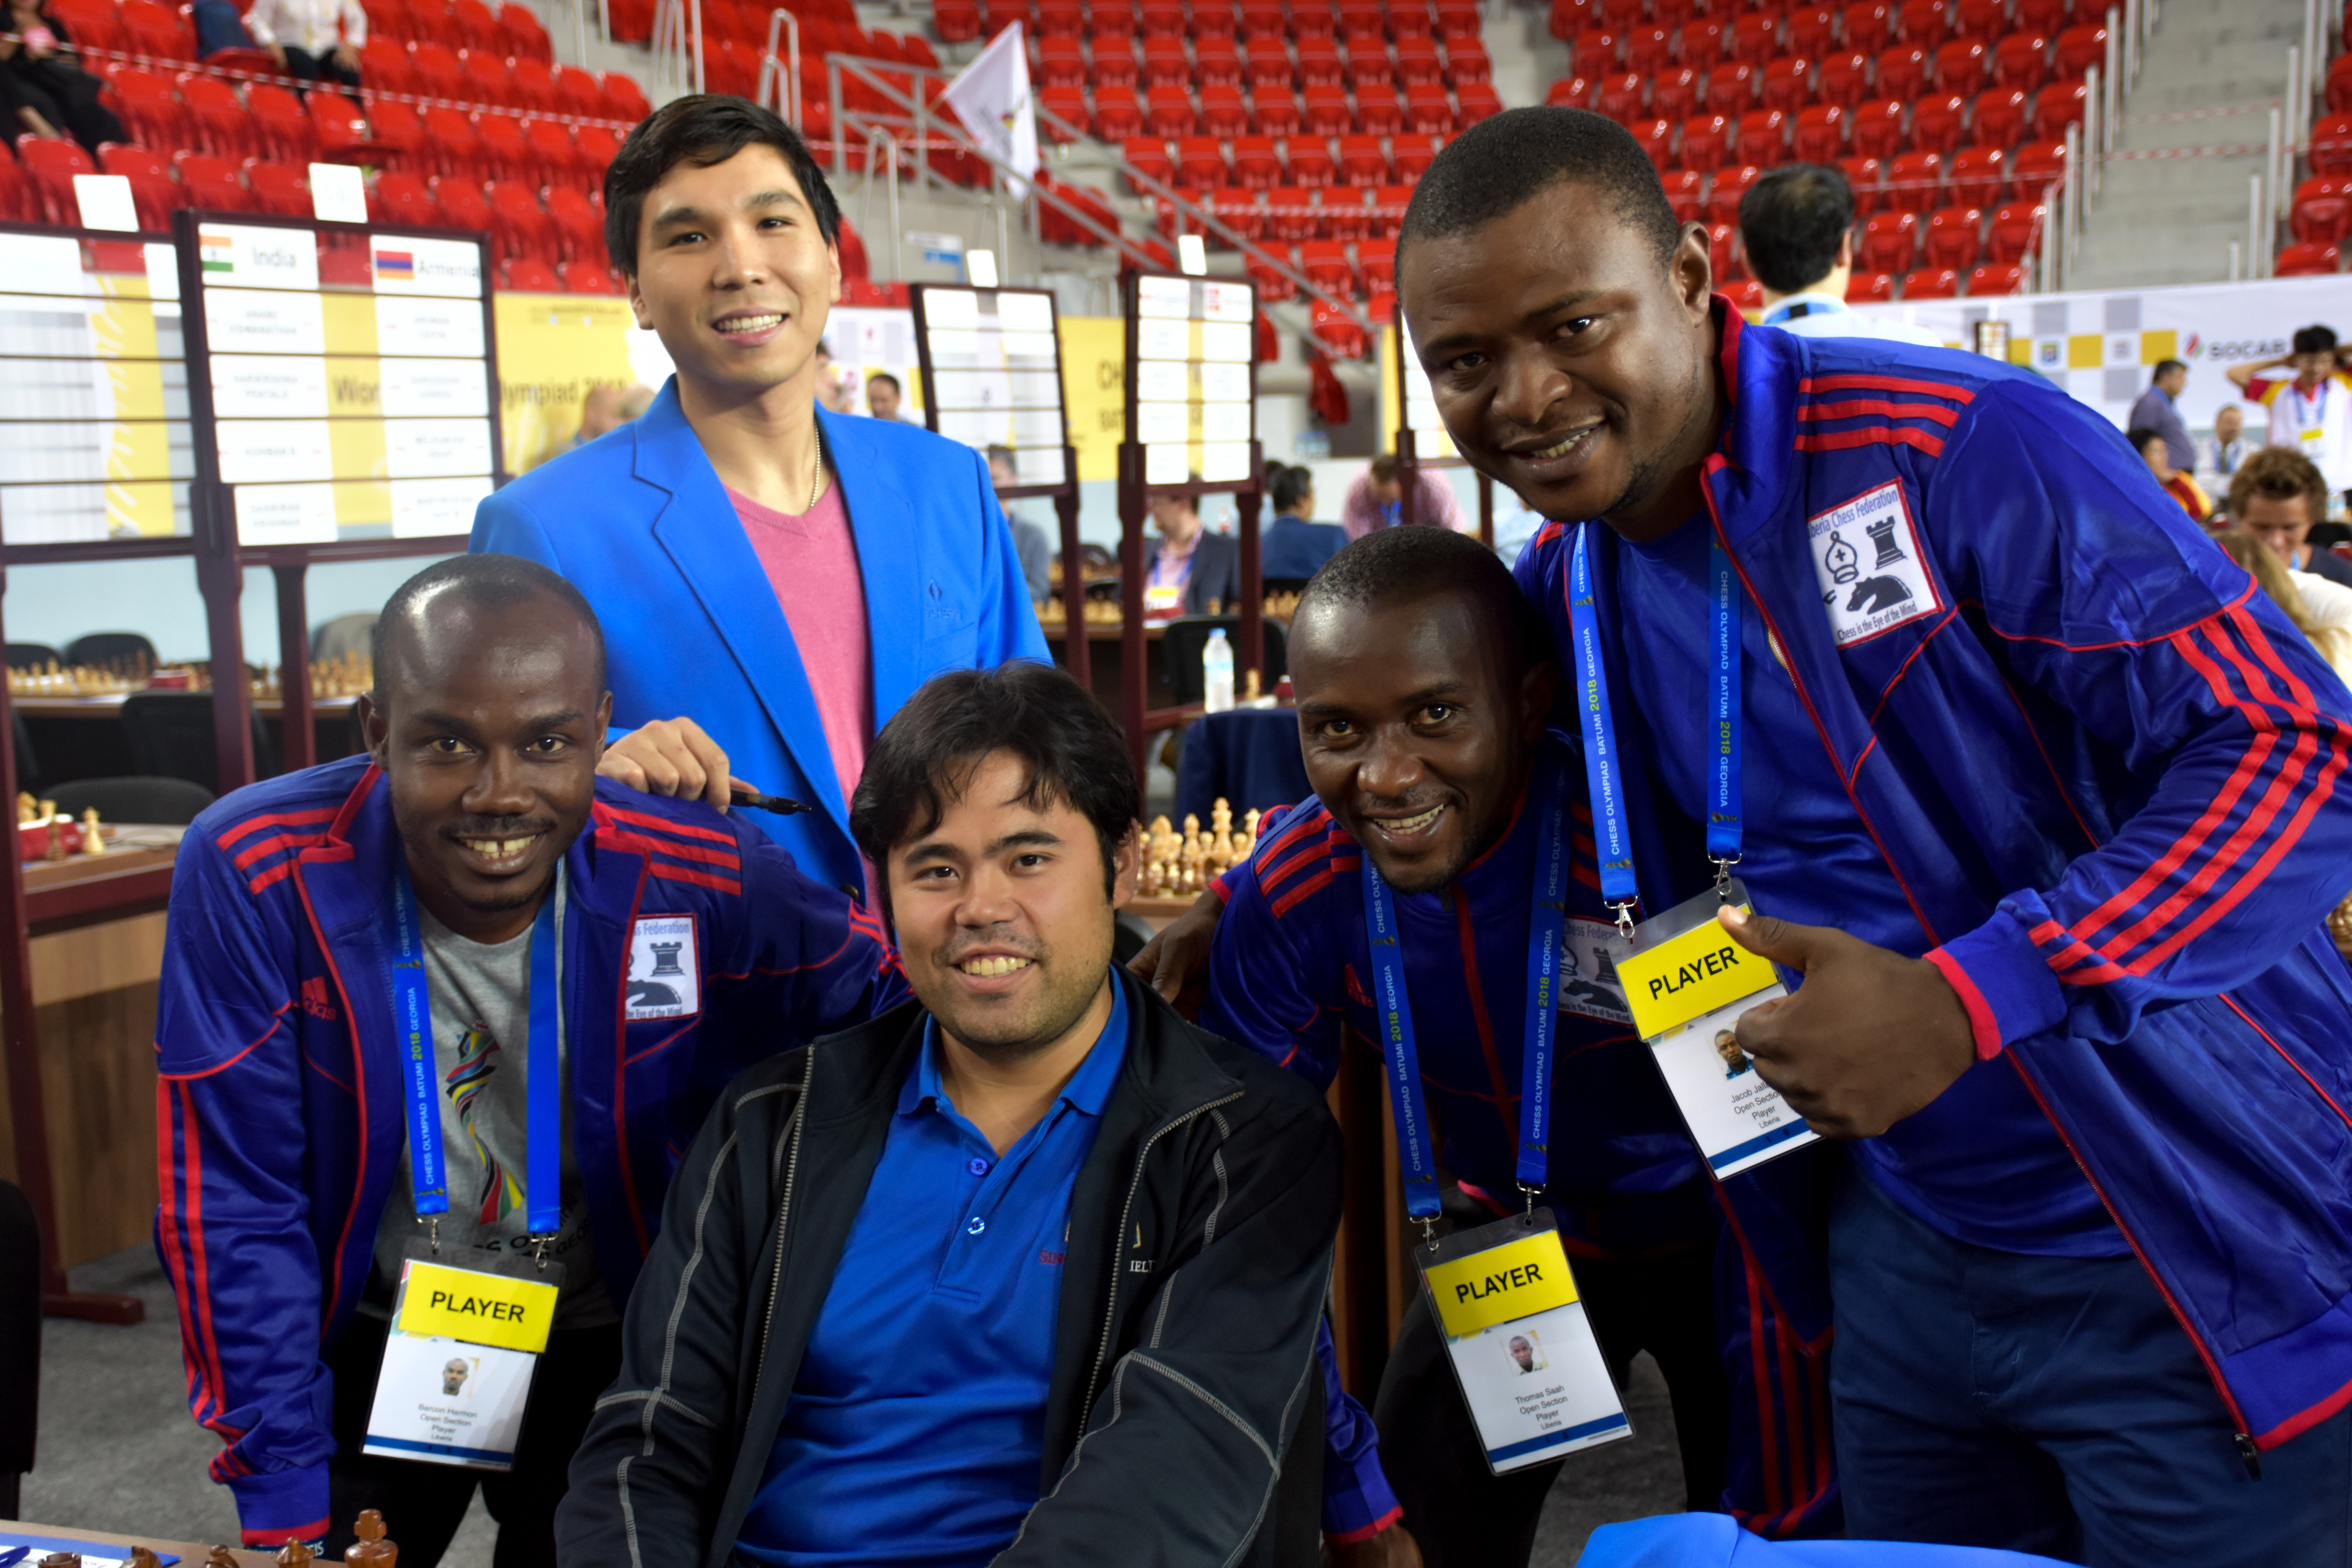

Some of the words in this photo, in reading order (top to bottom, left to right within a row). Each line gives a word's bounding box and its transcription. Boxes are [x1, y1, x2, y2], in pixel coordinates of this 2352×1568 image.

[252, 247, 296, 268] India
[1831, 507, 1855, 528] Chess
[1855, 488, 1898, 518] Federation
[1838, 624, 1857, 641] Chess
[1857, 622, 1862, 633] is
[1862, 618, 1873, 633] the
[1873, 615, 1885, 630] Eye
[1884, 612, 1891, 624] of
[1890, 608, 1900, 621] the
[1900, 600, 1917, 617] Mind
[1583, 628, 1596, 677] GEORGIA
[1720, 612, 1729, 670] OLYMPIAD
[1587, 679, 1600, 712] 2018
[1720, 676, 1728, 718] BATUMI
[1593, 714, 1606, 755] BATUMI
[1720, 721, 1731, 754] 2018
[1600, 760, 1614, 816] OLYMPIAD
[1720, 757, 1728, 807] GEORGIA
[1608, 818, 1620, 855] CHESS
[1548, 862, 1559, 896] CHESS
[644, 920, 690, 935] Federation
[1374, 899, 1385, 933] CHESS
[1543, 929, 1553, 975] GEORGIA
[1384, 965, 1397, 1010] GEORGIA
[1648, 946, 1740, 1000] PLAYER
[1538, 976, 1550, 1007] 2018
[407, 987, 419, 1031] GEORGIA
[636, 1009, 647, 1018] Eye
[1389, 1011, 1402, 1041] 2018
[1538, 1009, 1547, 1047] BATUMI
[410, 1032, 423, 1060] 2018
[1396, 1043, 1407, 1081] BATUMI
[415, 1062, 425, 1098] BATUMI
[1535, 1052, 1544, 1103] OLYMPIAD
[1402, 1085, 1416, 1137] OLYMPIAD
[1731, 1089, 1752, 1103] Jacob
[1734, 1102, 1755, 1114] Open
[1751, 1105, 1776, 1120] Player
[419, 1103, 430, 1151] OLYMPIAD
[1533, 1105, 1542, 1139] CHESS
[1759, 1116, 1781, 1129] Liberia
[423, 1150, 434, 1185] CHESS
[1409, 1138, 1421, 1171] CHESS
[1455, 1263, 1543, 1304] PLAYER
[430, 1290, 525, 1323] PLAYER
[1515, 1391, 1544, 1405] Thomas
[1545, 1385, 1564, 1396] Saah
[1520, 1404, 1540, 1415] Open
[1541, 1395, 1568, 1409] Section
[420, 1413, 441, 1423] Open
[443, 1417, 472, 1426] Section
[432, 1424, 456, 1434] Player
[448, 1408, 477, 1418] Harmon
[1535, 1409, 1559, 1421] Player
[1541, 1419, 1562, 1430] Liberia
